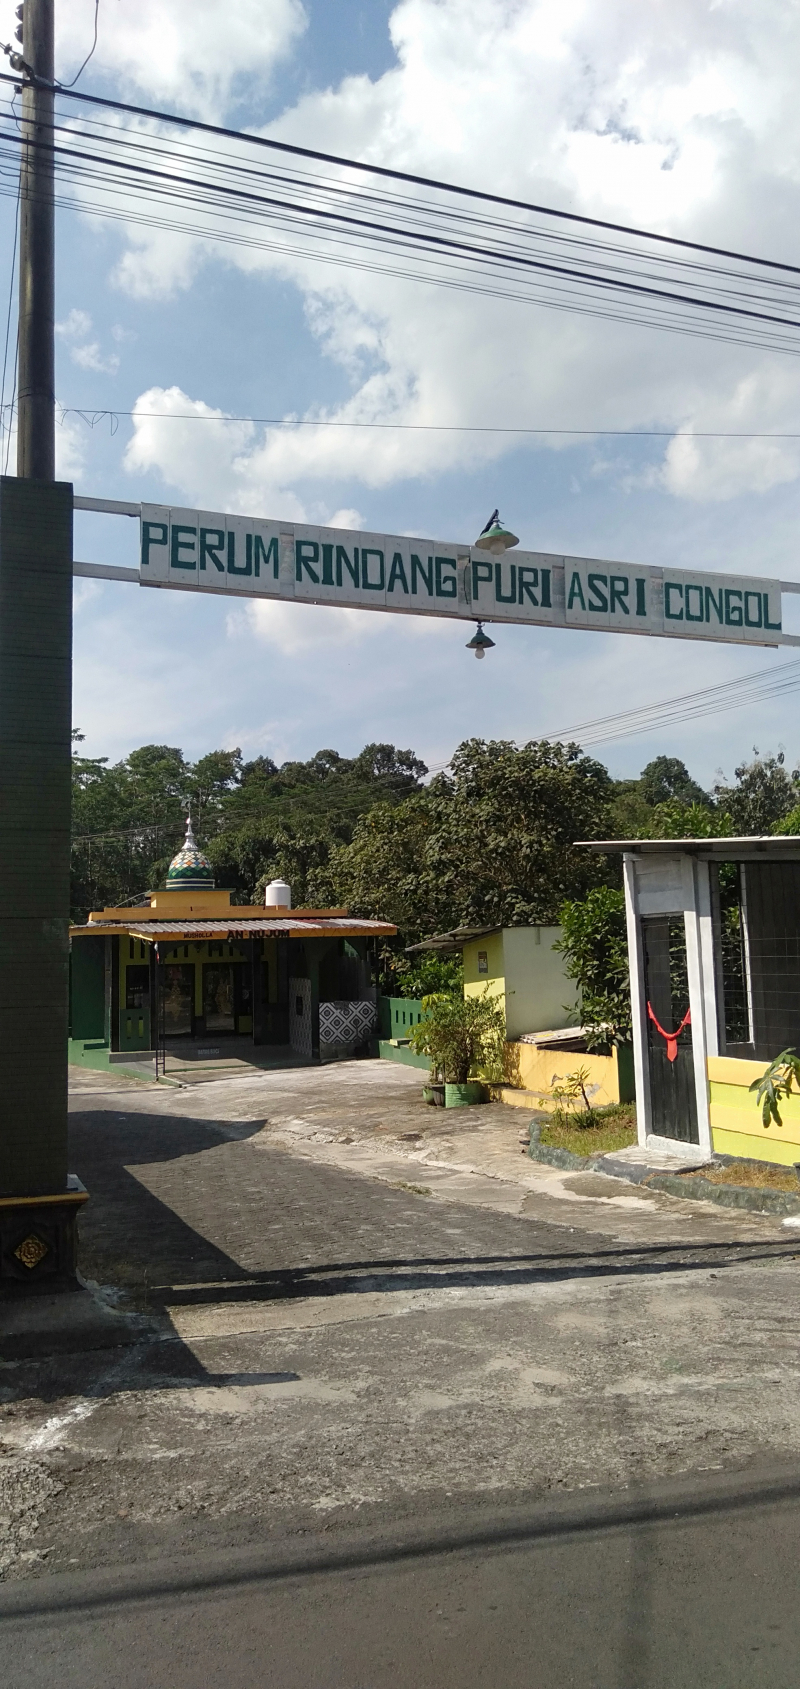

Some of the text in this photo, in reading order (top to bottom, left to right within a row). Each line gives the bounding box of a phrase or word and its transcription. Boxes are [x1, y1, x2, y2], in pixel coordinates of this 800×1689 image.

[141, 521, 782, 631] PERUM RINDANG PURI ASRI CONGOL
